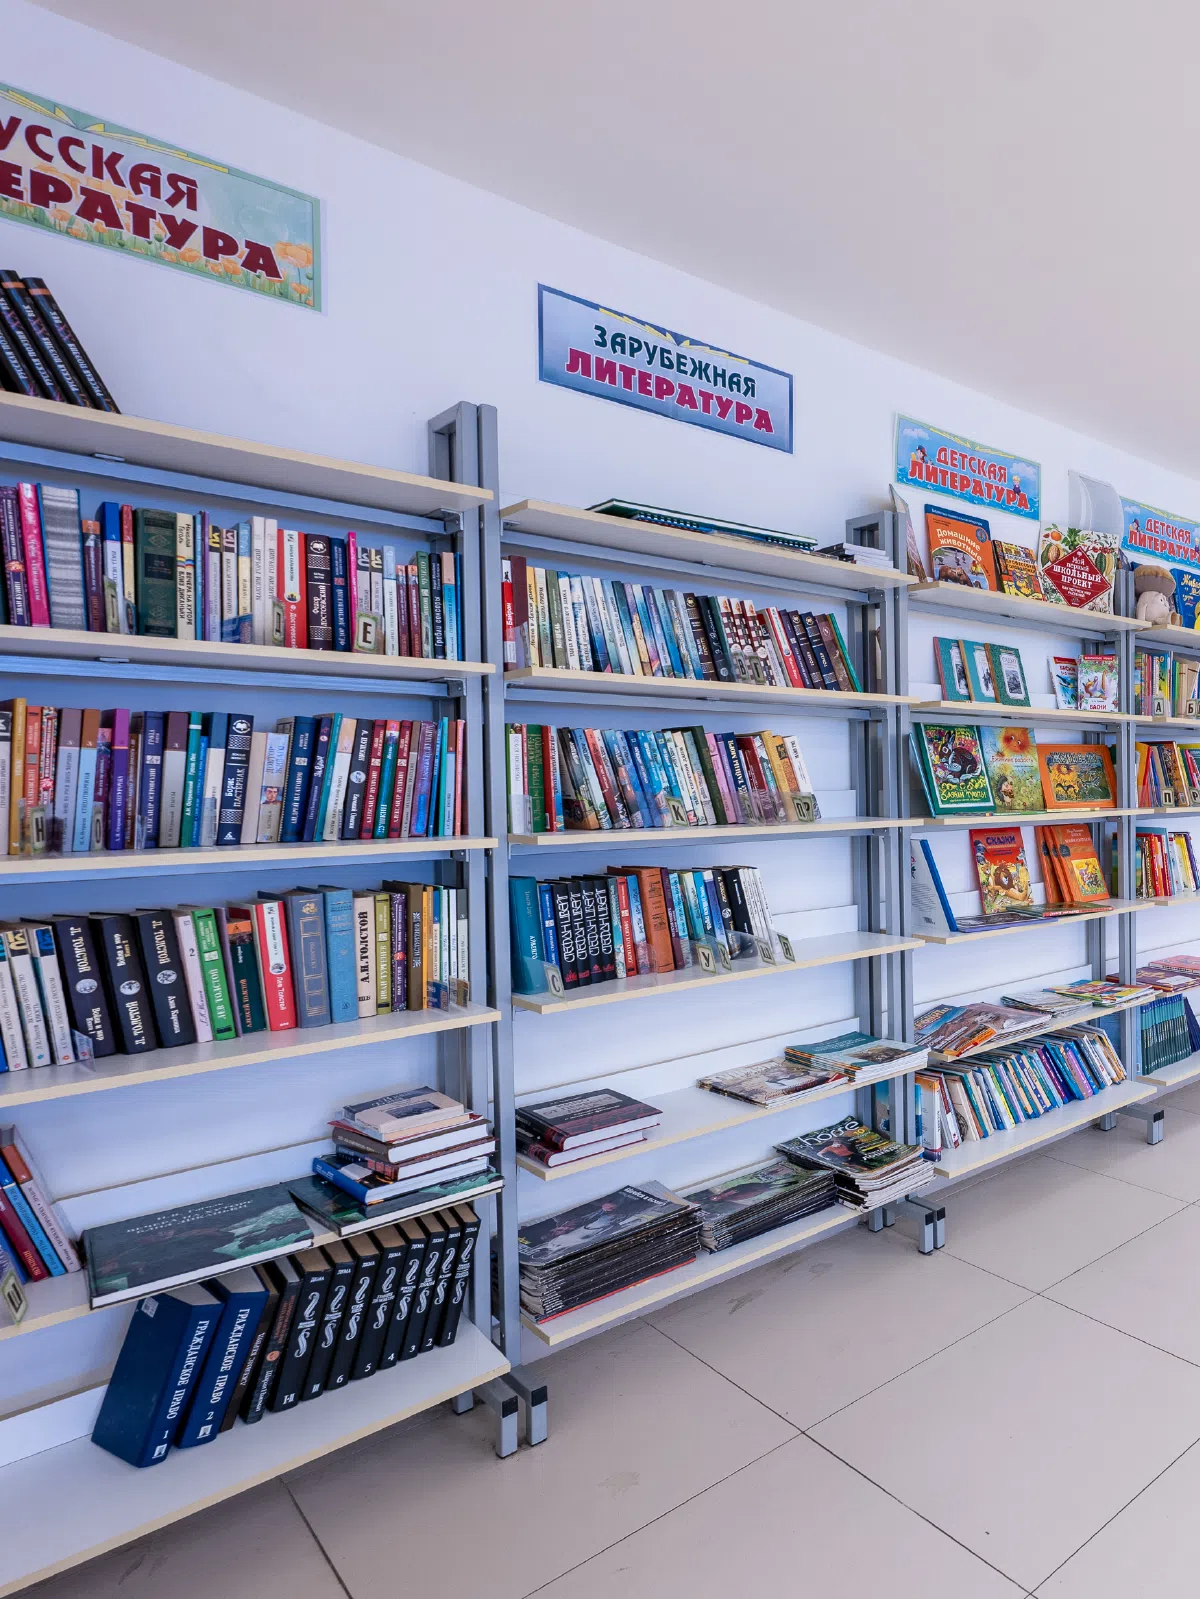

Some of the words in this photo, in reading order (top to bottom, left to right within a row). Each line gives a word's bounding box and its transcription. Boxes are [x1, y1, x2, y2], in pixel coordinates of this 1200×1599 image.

[0, 160, 283, 280] ЕРАТУРА
[594, 324, 756, 398] ЗАРУБЕЖНАЯ
[566, 347, 774, 433] ЛИТЕРАТУРА
[936, 446, 1007, 483] ДЕТСКАЯ
[909, 459, 1030, 511] ЛИТЕРАТУРА
[936, 528, 980, 552] Домашние
[1146, 518, 1191, 544] ДЕТСКАЯ
[939, 538, 982, 561] животные
[1053, 565, 1101, 582] ШКОЛЬНЫЙ
[1061, 575, 1092, 589] ПРОЕКТ
[319, 585, 327, 627] ДОСТОЕВСКИЙ
[363, 621, 372, 645] Е
[225, 777, 234, 796] Борис
[234, 768, 245, 807] ПАСТЕРНАК
[672, 804, 684, 821] К
[796, 802, 806, 818] П
[985, 836, 1016, 846] СКАЗКИ
[557, 894, 570, 923] ЦВЕЙГ
[571, 892, 583, 921] ЦВЕЙГ
[583, 890, 595, 918] ЦВЕЙГ
[595, 888, 607, 916] ЦВЕЙГ
[70, 927, 79, 935] Л.
[152, 920, 162, 928] Л.
[586, 920, 599, 956] СТЕФАН
[599, 917, 612, 954] СТЕФАН
[72, 937, 90, 973] ТОЛСТОЙ
[154, 930, 170, 964] ТОЛСТОЙ
[359, 911, 369, 983] А.Н.ТОЛСТОЙ
[561, 924, 574, 962] СТЕФАН
[574, 922, 587, 960] СТЕФАН
[116, 950, 125, 966] Война
[703, 951, 711, 968] У
[210, 968, 224, 1002] ТОЛСТОЙ
[552, 977, 561, 993] С
[92, 1008, 100, 1023] Война
[126, 1001, 142, 1035] ТОЛСТОЙ
[136, 1036, 145, 1045] Л.
[178, 1319, 210, 1382] ГРАЖДАНСКОЕ
[219, 1308, 250, 1370] ГРАЖДАНСКОЕ
[387, 1353, 395, 1361] 4
[209, 1371, 229, 1404] ПРАВО
[336, 1375, 344, 1383] 6
[166, 1383, 188, 1419] ПРАВО
[206, 1410, 214, 1420] 2
